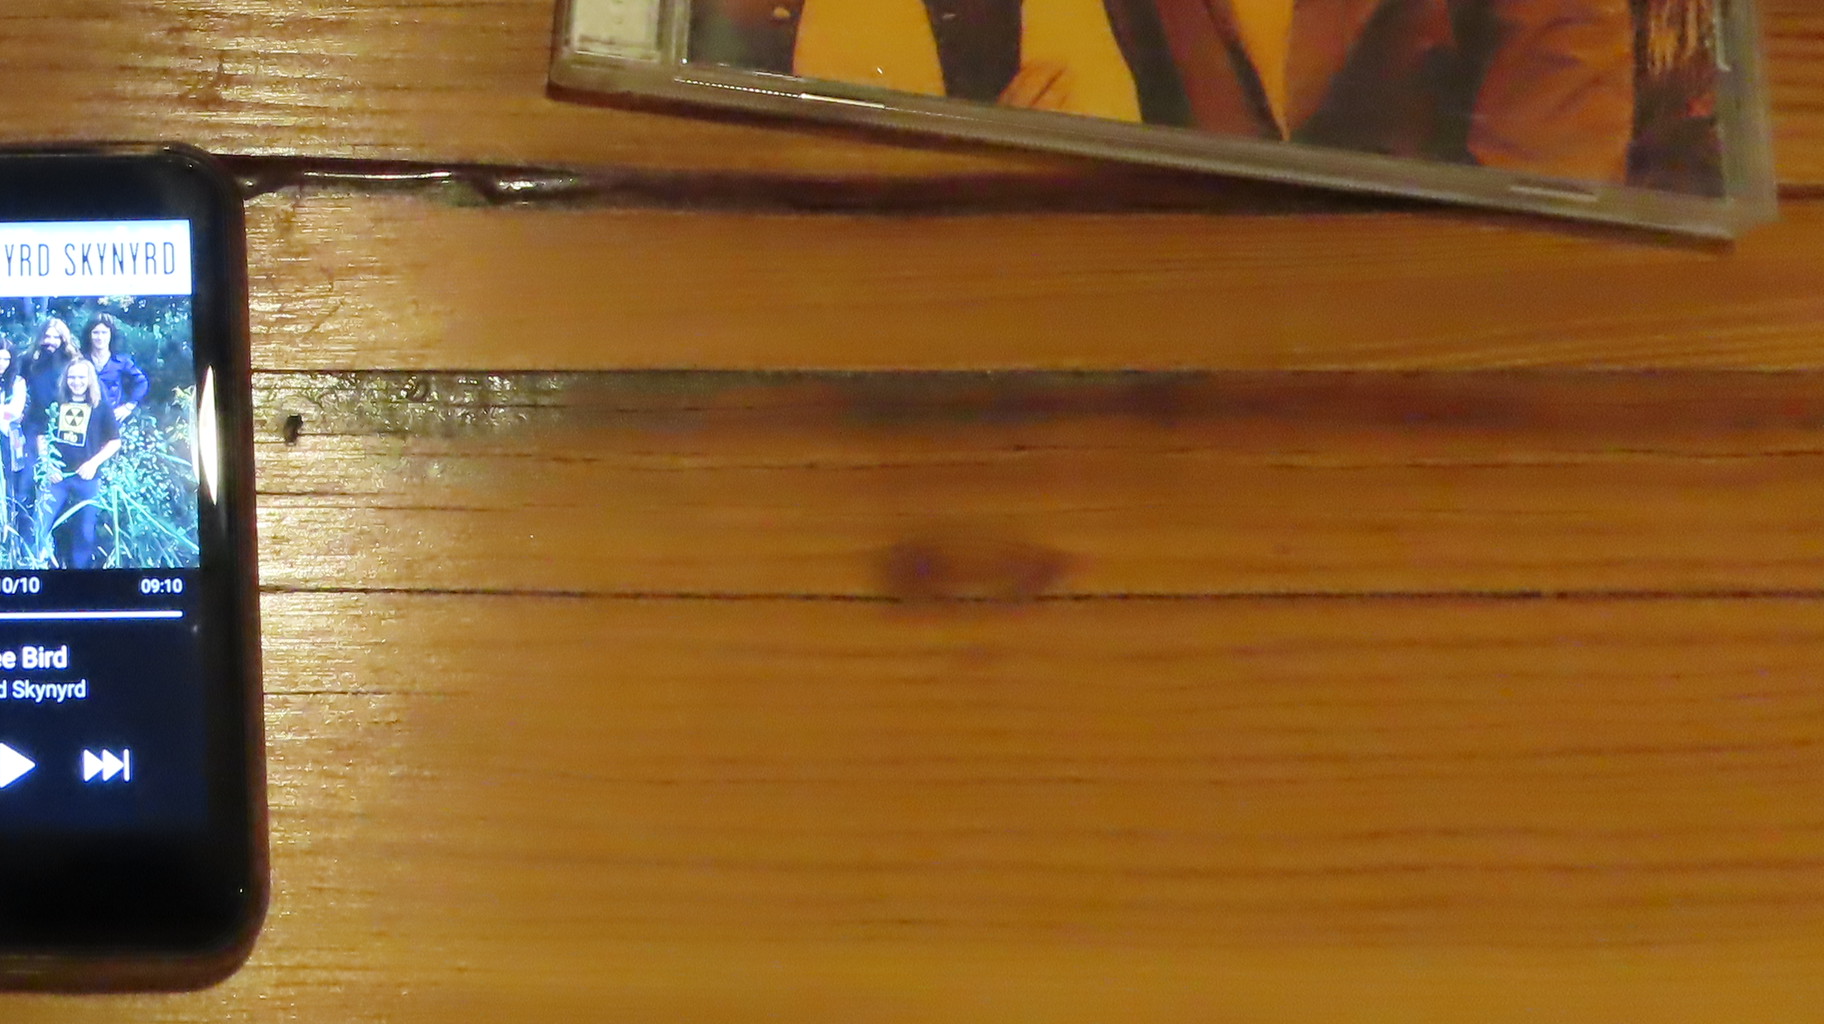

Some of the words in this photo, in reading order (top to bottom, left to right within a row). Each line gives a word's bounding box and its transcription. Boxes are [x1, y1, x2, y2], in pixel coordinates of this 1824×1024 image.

[64, 241, 176, 277] SKYNYRD
[140, 578, 184, 595] 09:10
[22, 645, 68, 669] Bird
[12, 679, 87, 703] Skynyrd
